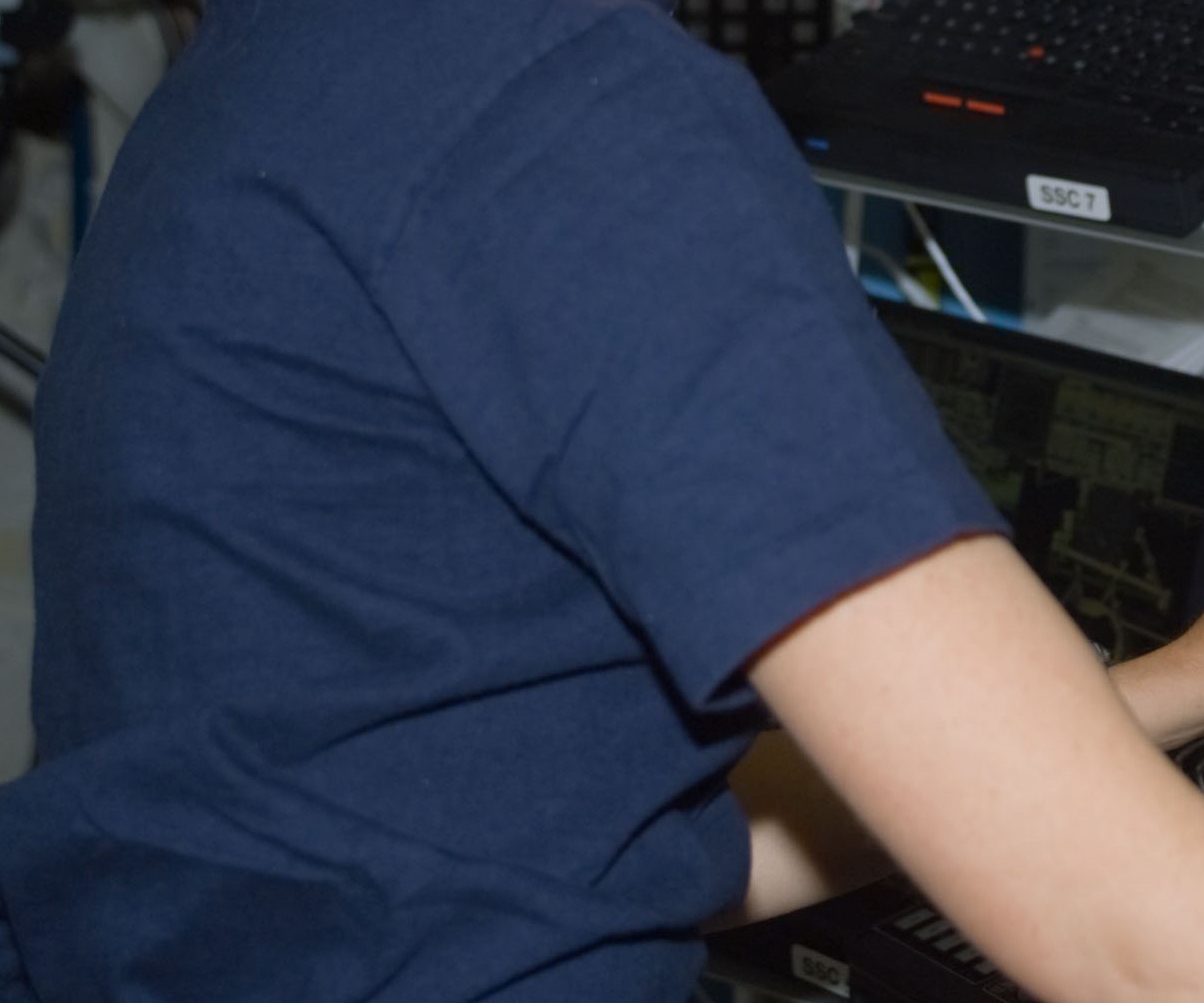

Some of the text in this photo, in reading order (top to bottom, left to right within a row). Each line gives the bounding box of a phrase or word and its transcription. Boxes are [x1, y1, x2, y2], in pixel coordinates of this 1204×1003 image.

[1041, 184, 1096, 212] SSC 7
[802, 957, 840, 986] SSC
